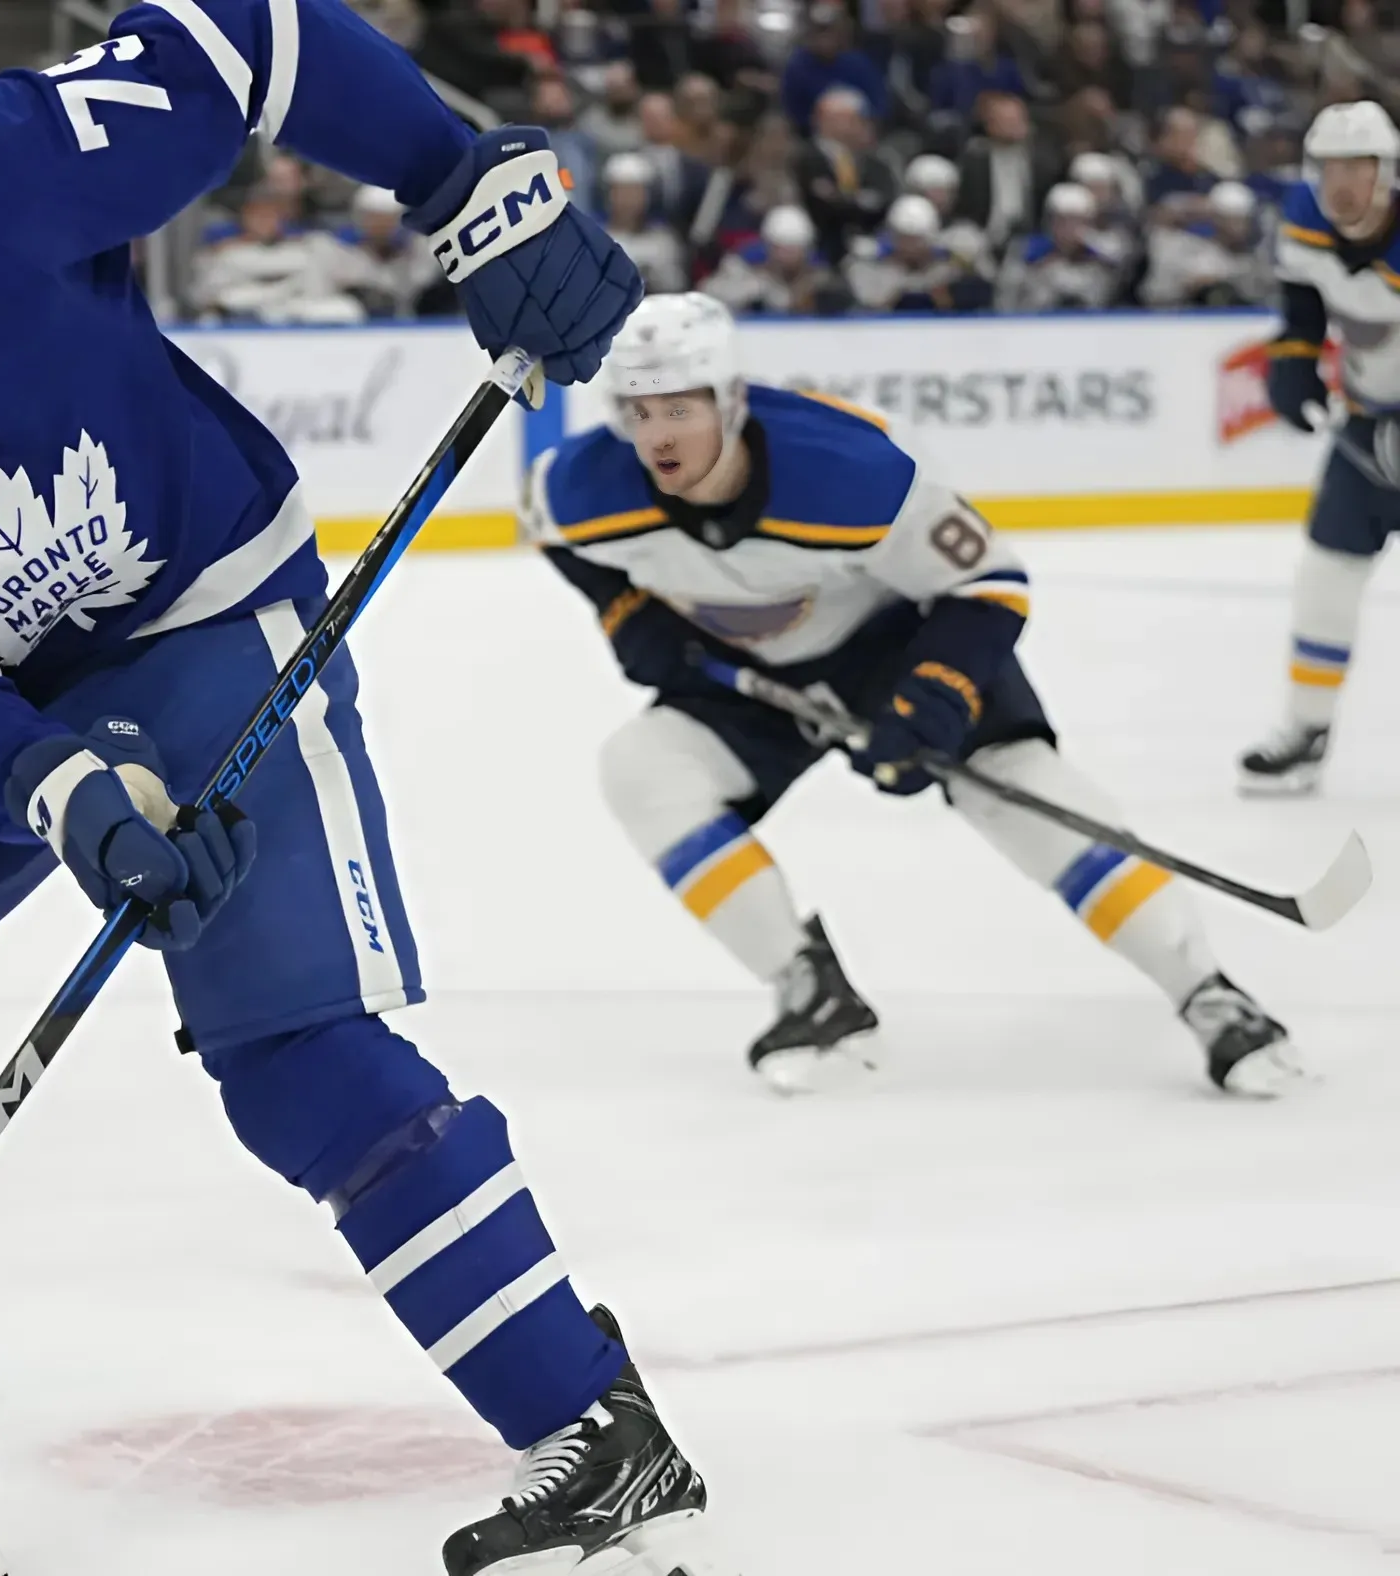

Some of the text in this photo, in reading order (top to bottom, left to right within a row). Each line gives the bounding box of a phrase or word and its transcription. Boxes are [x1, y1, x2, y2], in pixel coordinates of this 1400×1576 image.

[434, 172, 553, 277] CCM
[929, 493, 996, 572] 8
[4, 551, 107, 634] MAPLE
[348, 859, 385, 954] CCM
